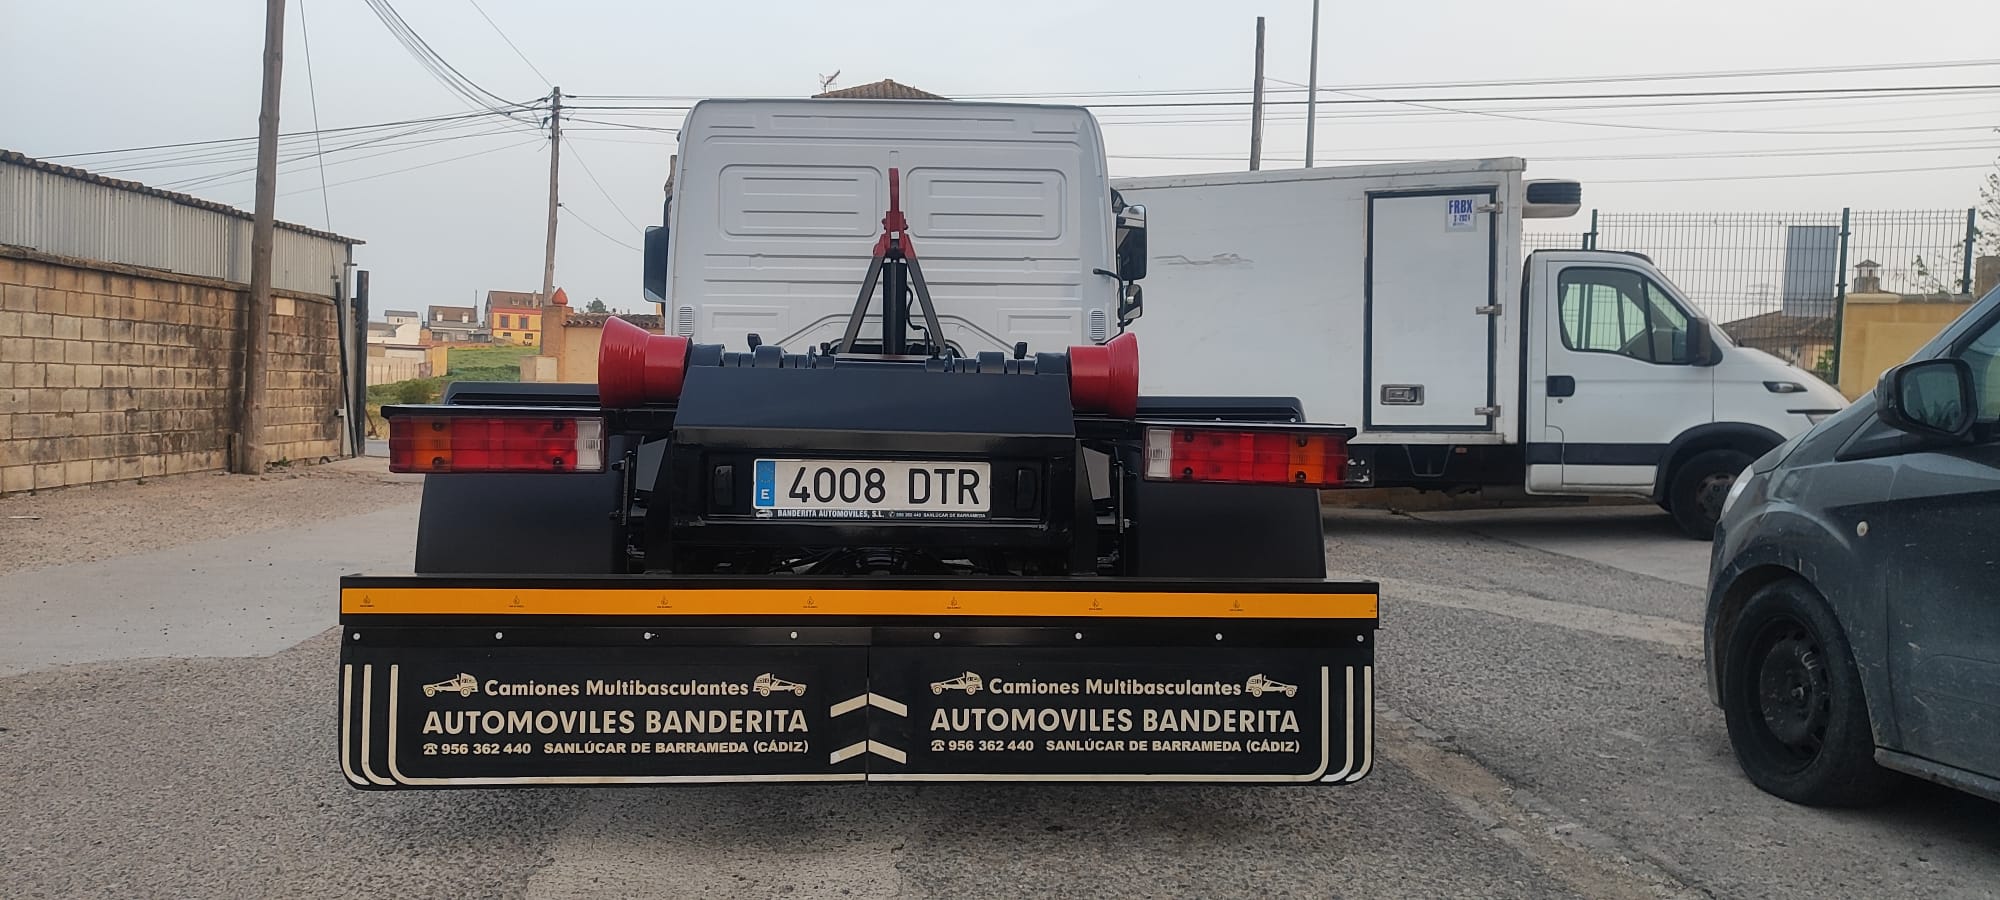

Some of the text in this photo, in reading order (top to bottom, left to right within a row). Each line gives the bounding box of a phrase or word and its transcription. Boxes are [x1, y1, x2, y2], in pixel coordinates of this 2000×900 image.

[1449, 199, 1473, 214] FRBX
[789, 467, 980, 504] 4008 DTR
[760, 489, 770, 500] E
[777, 509, 817, 518] BANDERITA
[484, 679, 749, 696] Camiones Multibasculantes
[989, 678, 1242, 696] Camiones Multibasculantes
[422, 709, 809, 735] AUTOMOVILES BANDERITA
[930, 707, 1300, 733] AUTOMOVILES BANDERITA
[441, 739, 809, 755] 956 362 440 SANLÚCAR DE BARRAMEDA (CÁDIZ)
[948, 738, 1300, 754] 956 362 440 SANLÚCAR DE BARRAMEDA (CÁDIZ)
